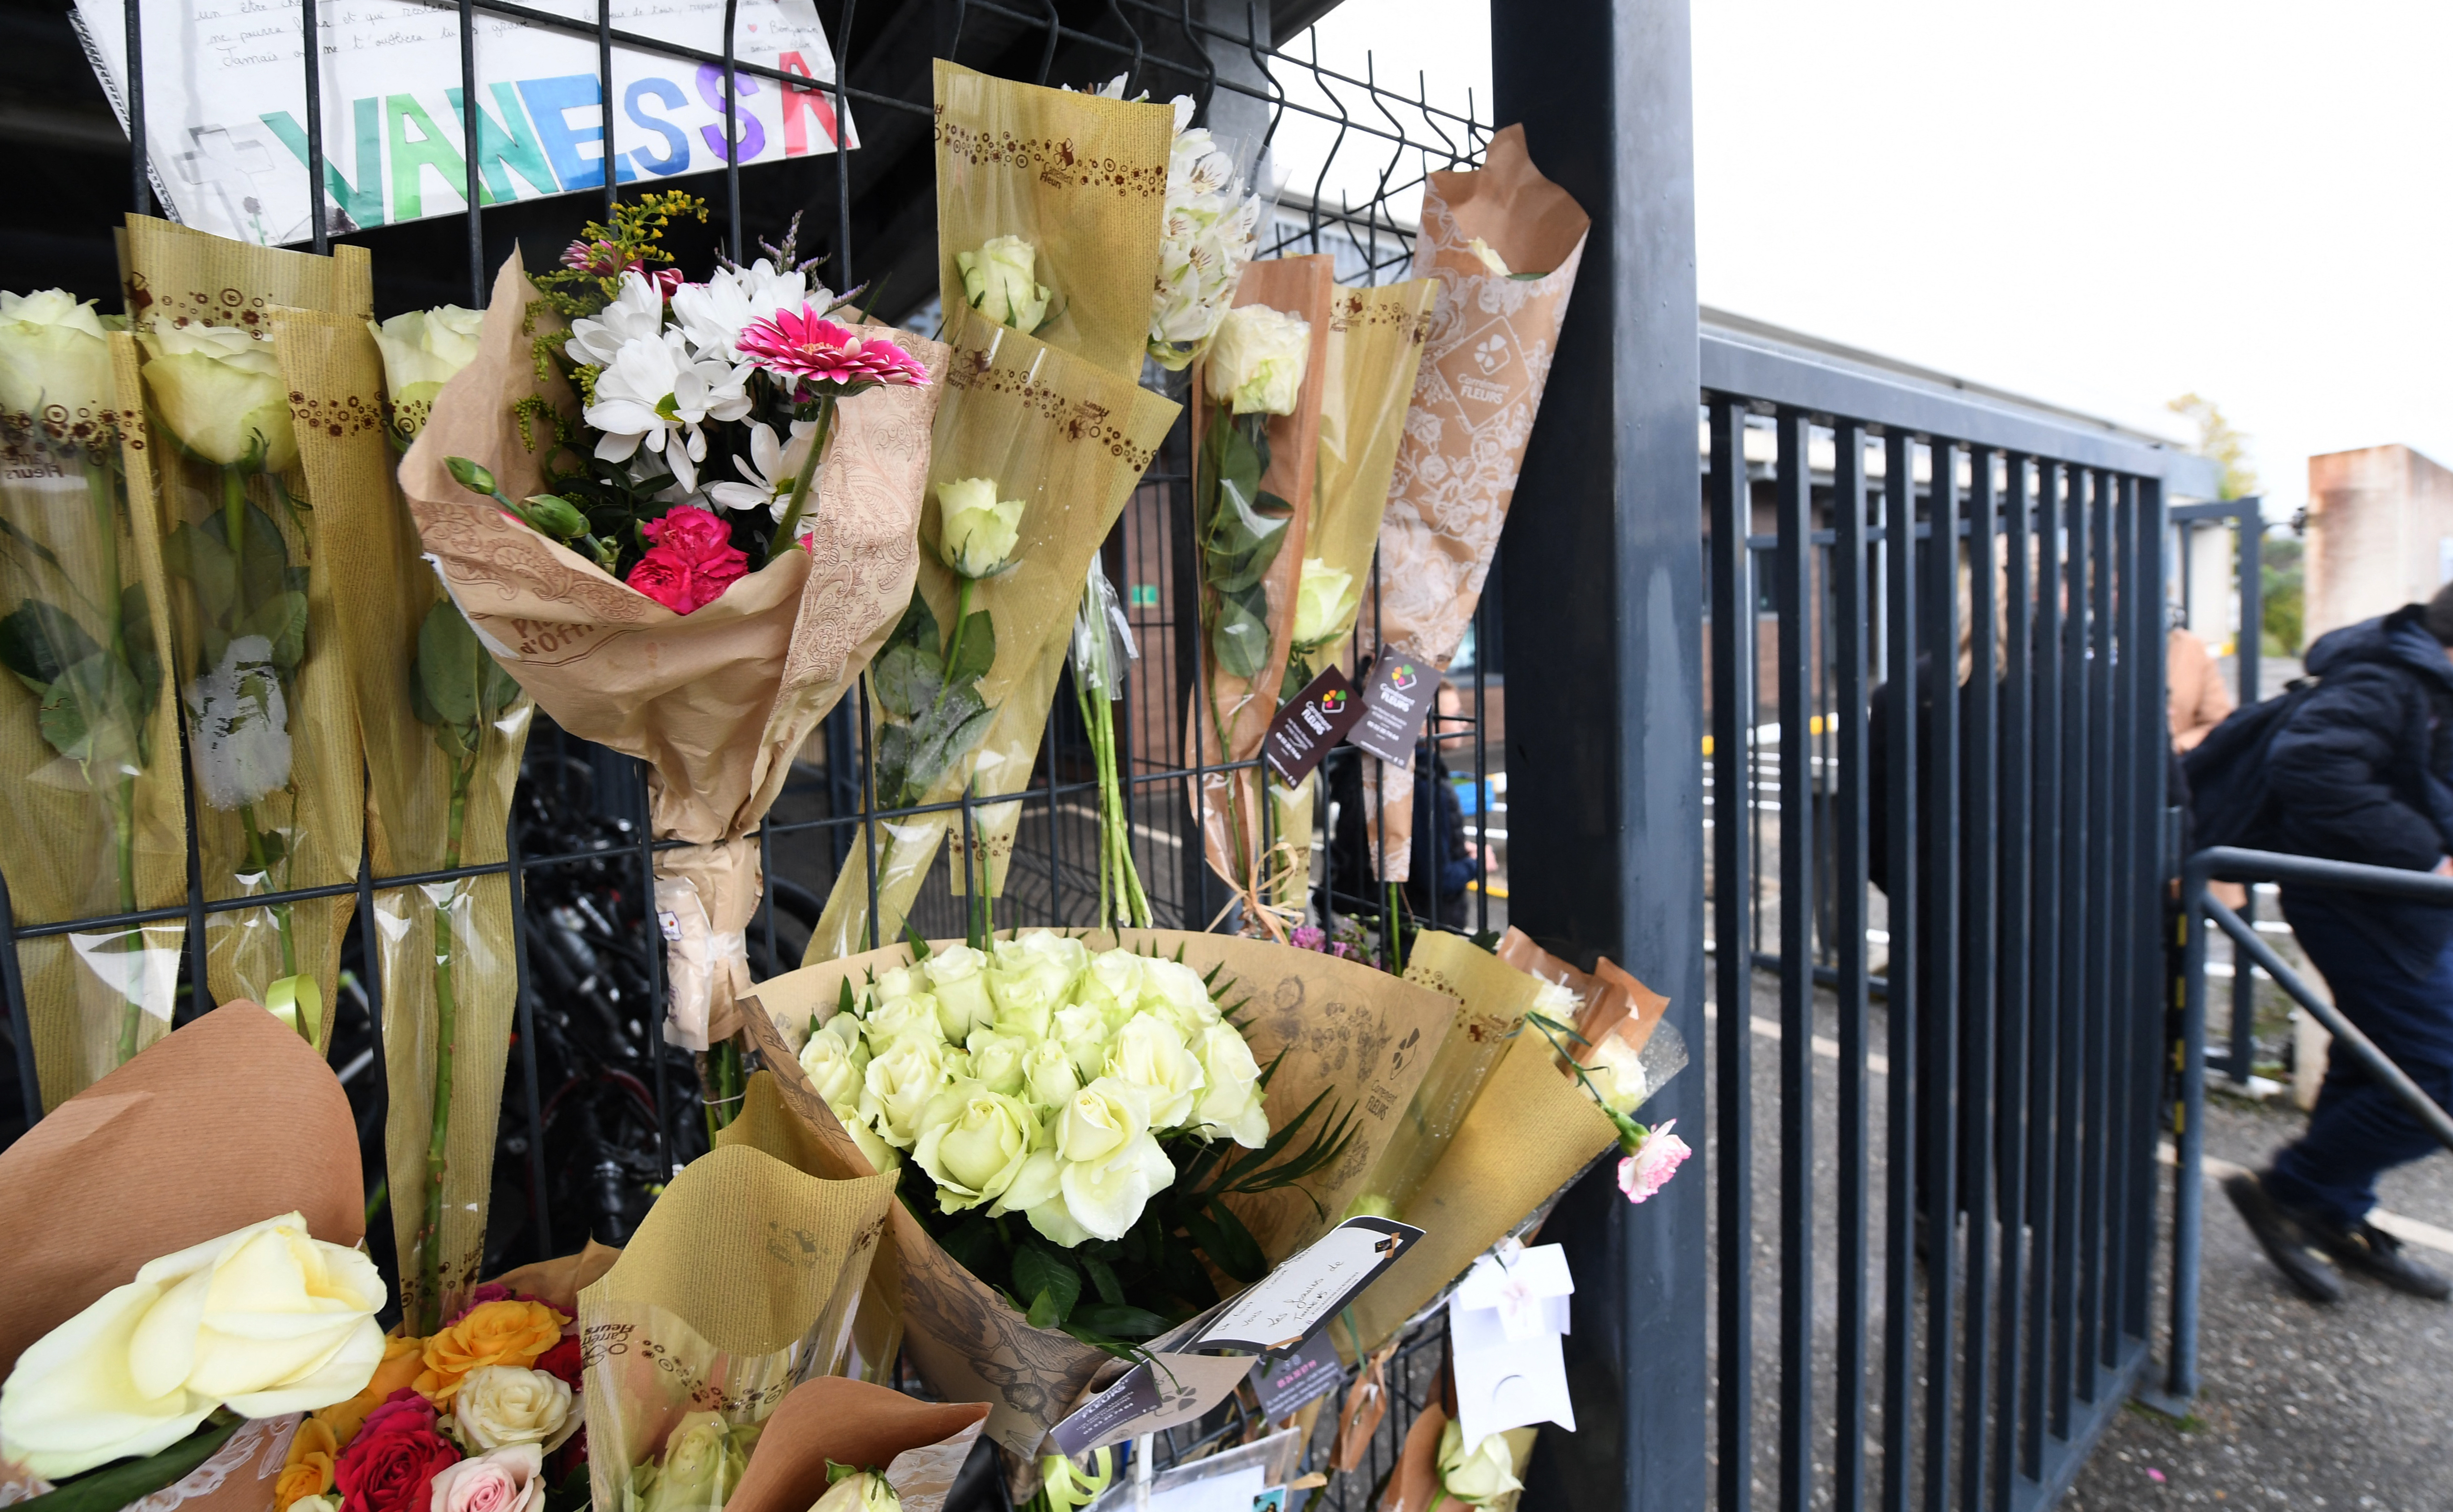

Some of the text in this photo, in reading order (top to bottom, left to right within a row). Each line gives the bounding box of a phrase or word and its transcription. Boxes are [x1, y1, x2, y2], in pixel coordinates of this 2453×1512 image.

[195, 11, 221, 21] un
[241, 0, 268, 12] être
[209, 34, 230, 45] ne
[240, 27, 284, 43] pourra
[343, 11, 356, 23] et
[366, 11, 385, 25] qui
[403, 1, 454, 16] restera
[770, 20, 818, 36] Benjamin
[216, 46, 278, 67] Jamais
[323, 45, 338, 54] ne
[441, 27, 455, 38] tu
[584, 9, 592, 20] le
[633, 7, 643, 16] de
[259, 51, 852, 229] VANESSA
[1040, 172, 1061, 189] Fleurs
[1461, 385, 1503, 405] FLEURS
[1083, 399, 1110, 417] Fleurs
[1381, 691, 1409, 712] FLEURS
[1301, 709, 1326, 735] FLEURS
[1365, 1095, 1389, 1121] FLEURS
[1268, 1313, 1288, 1327] Les
[1328, 1261, 1344, 1272] de
[584, 1324, 635, 1335] Fleurs
